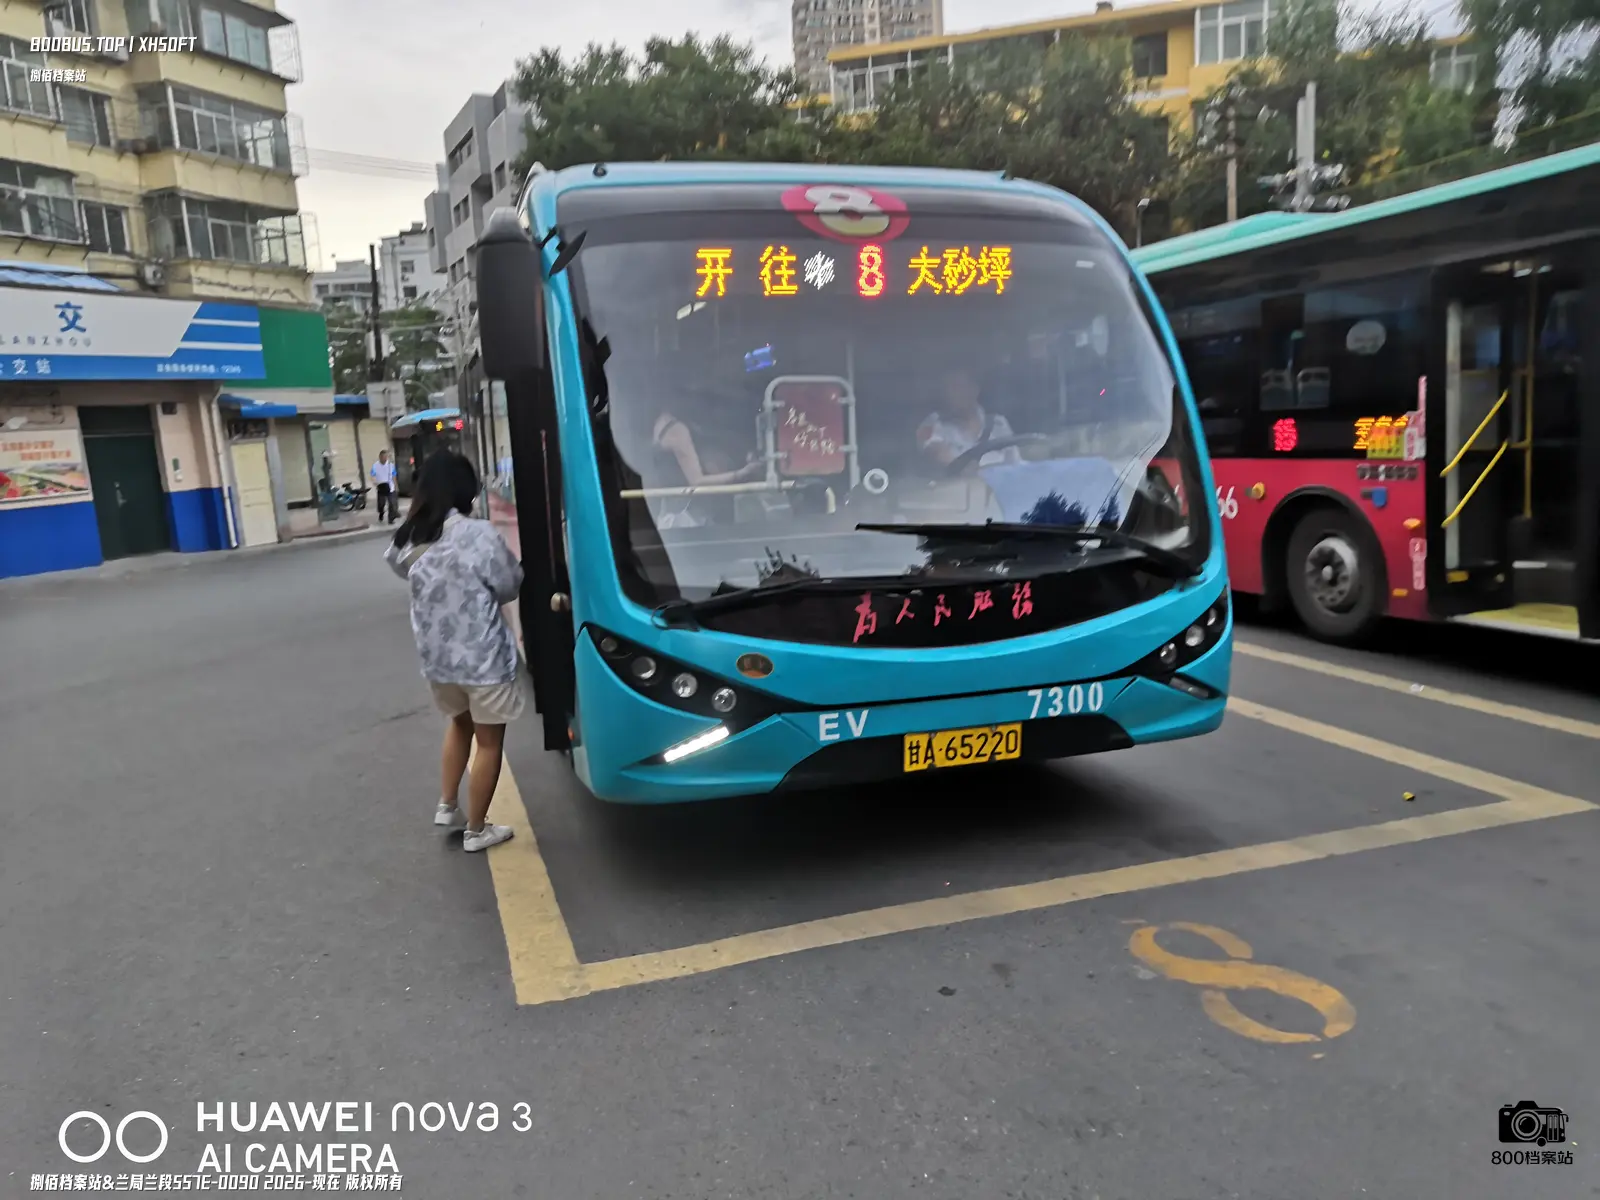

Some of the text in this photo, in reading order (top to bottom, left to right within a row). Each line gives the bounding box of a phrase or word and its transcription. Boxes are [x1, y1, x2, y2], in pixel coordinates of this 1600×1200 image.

[804, 185, 890, 236] 8
[695, 243, 1013, 297] 开往 8 大砂坪
[54, 301, 87, 333] 交
[0, 358, 52, 376] 交站
[1027, 681, 1104, 720] 7300
[818, 709, 870, 741] EV
[1129, 921, 1356, 1044] 8
